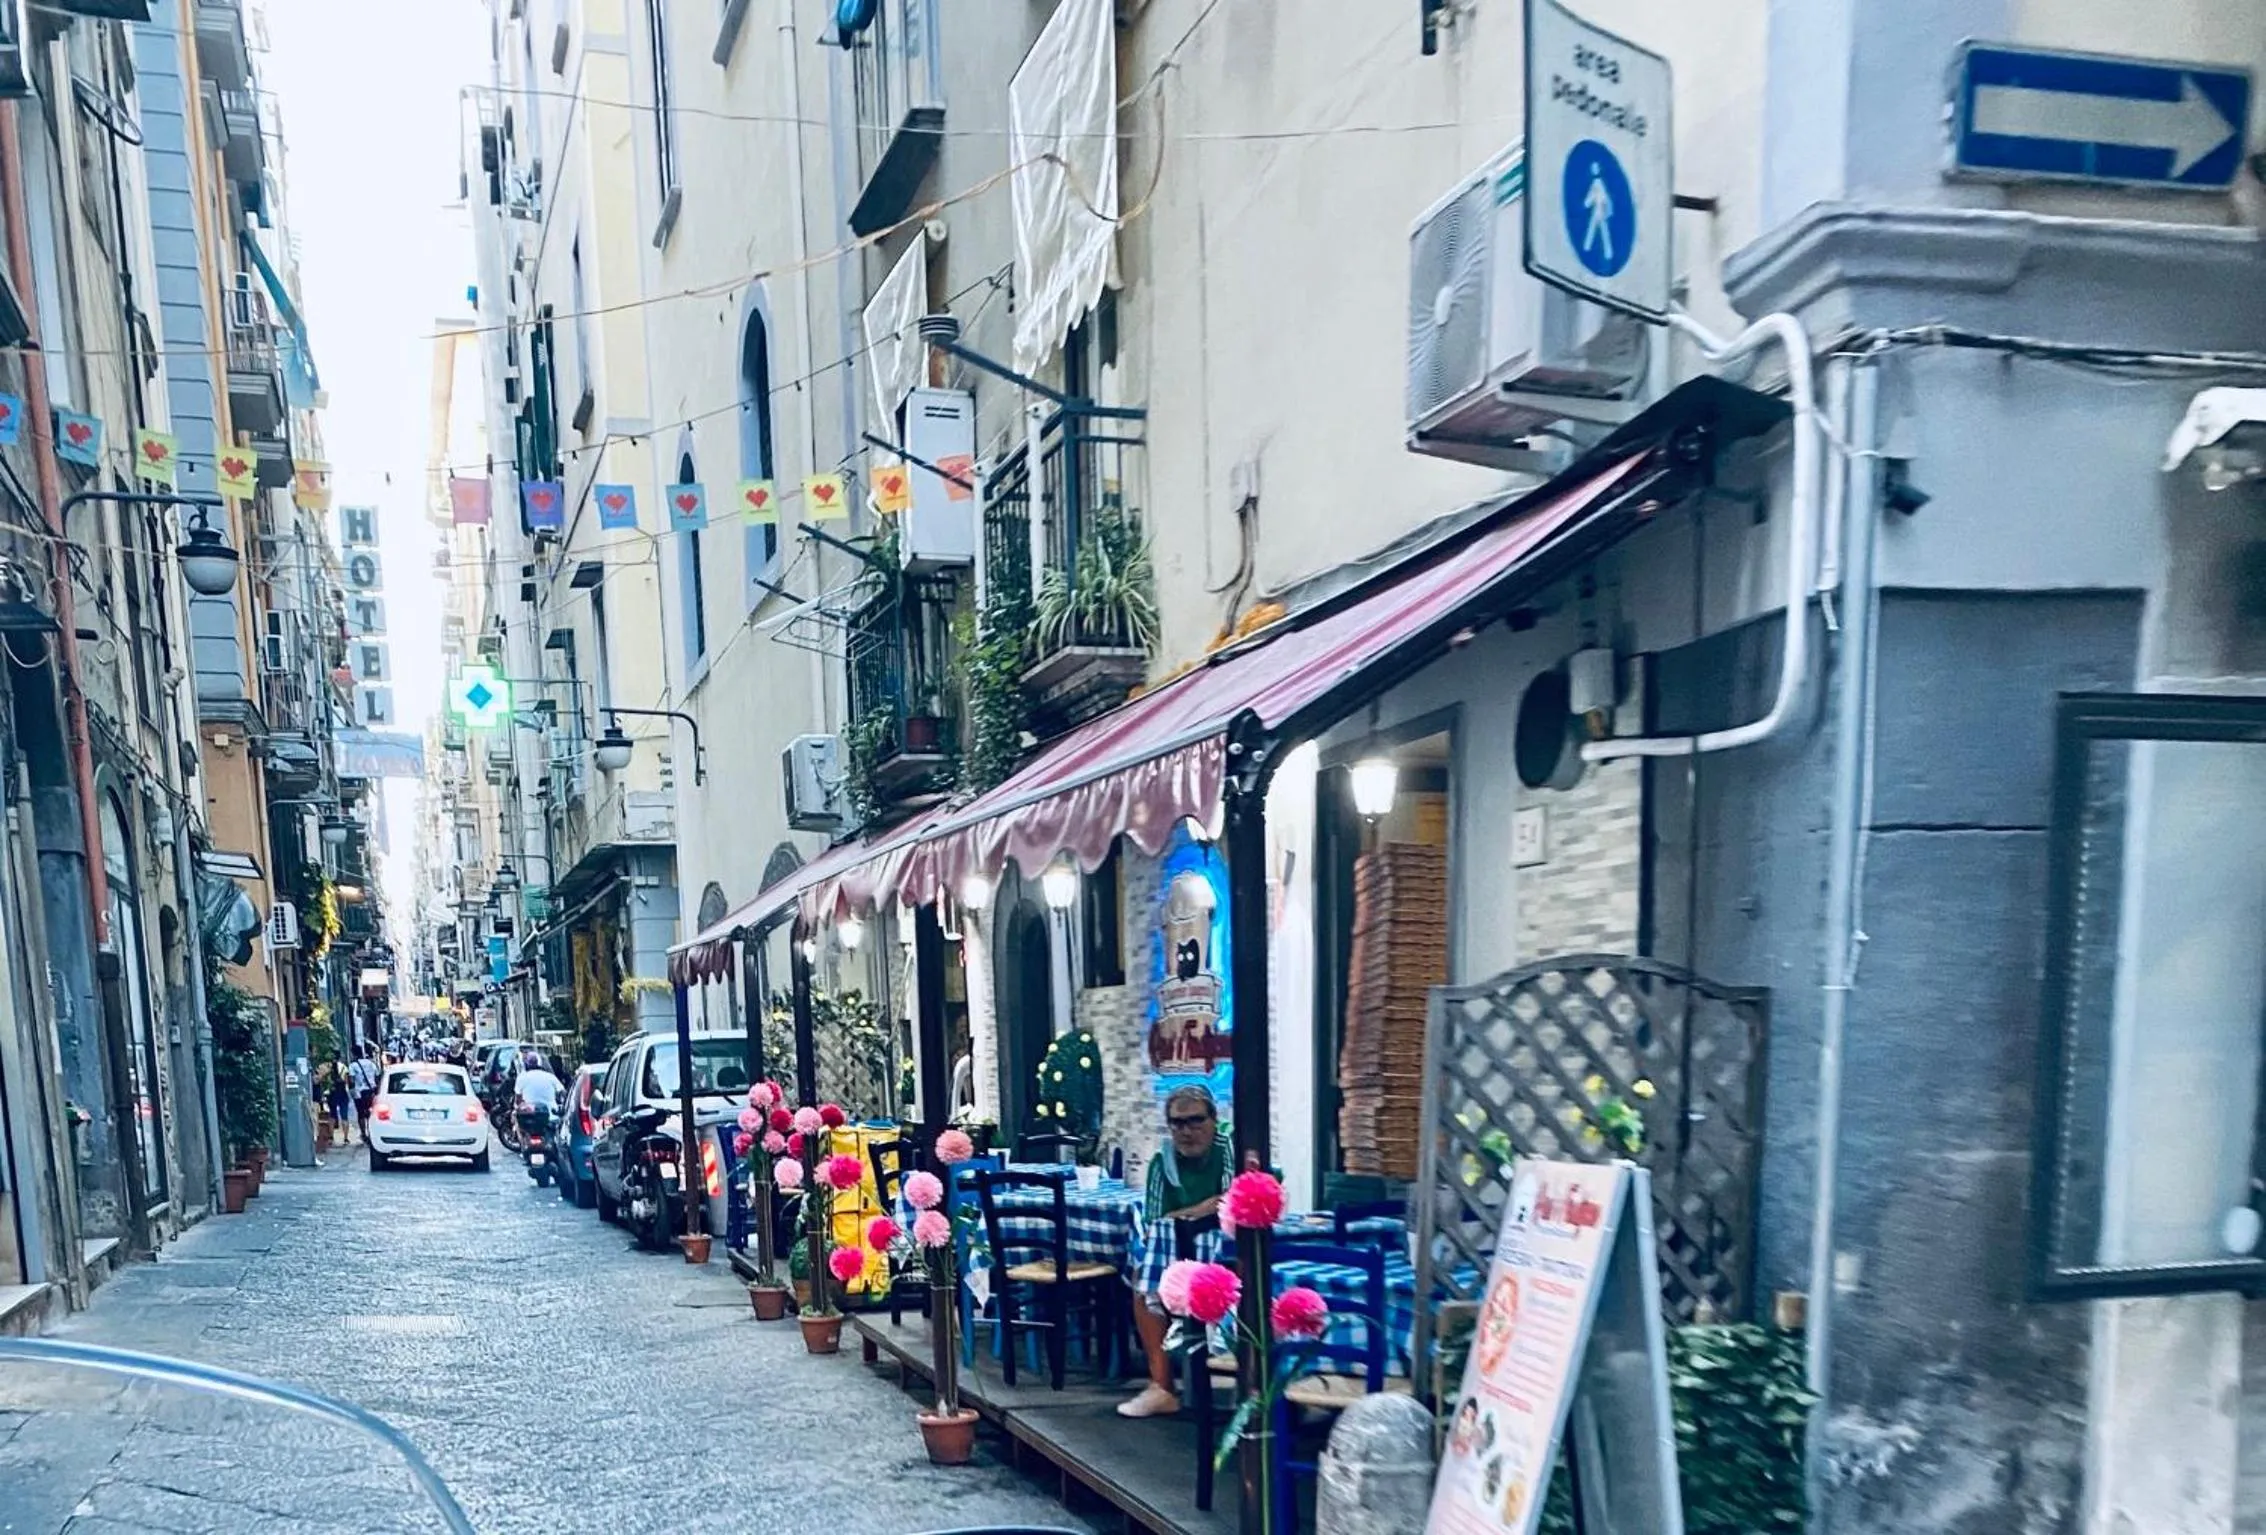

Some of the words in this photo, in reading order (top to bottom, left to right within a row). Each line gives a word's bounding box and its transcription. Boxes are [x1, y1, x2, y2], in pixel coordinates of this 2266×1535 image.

[1573, 43, 1620, 84] area
[1552, 74, 1647, 138] pedonale
[347, 508, 385, 721] HOTEL
